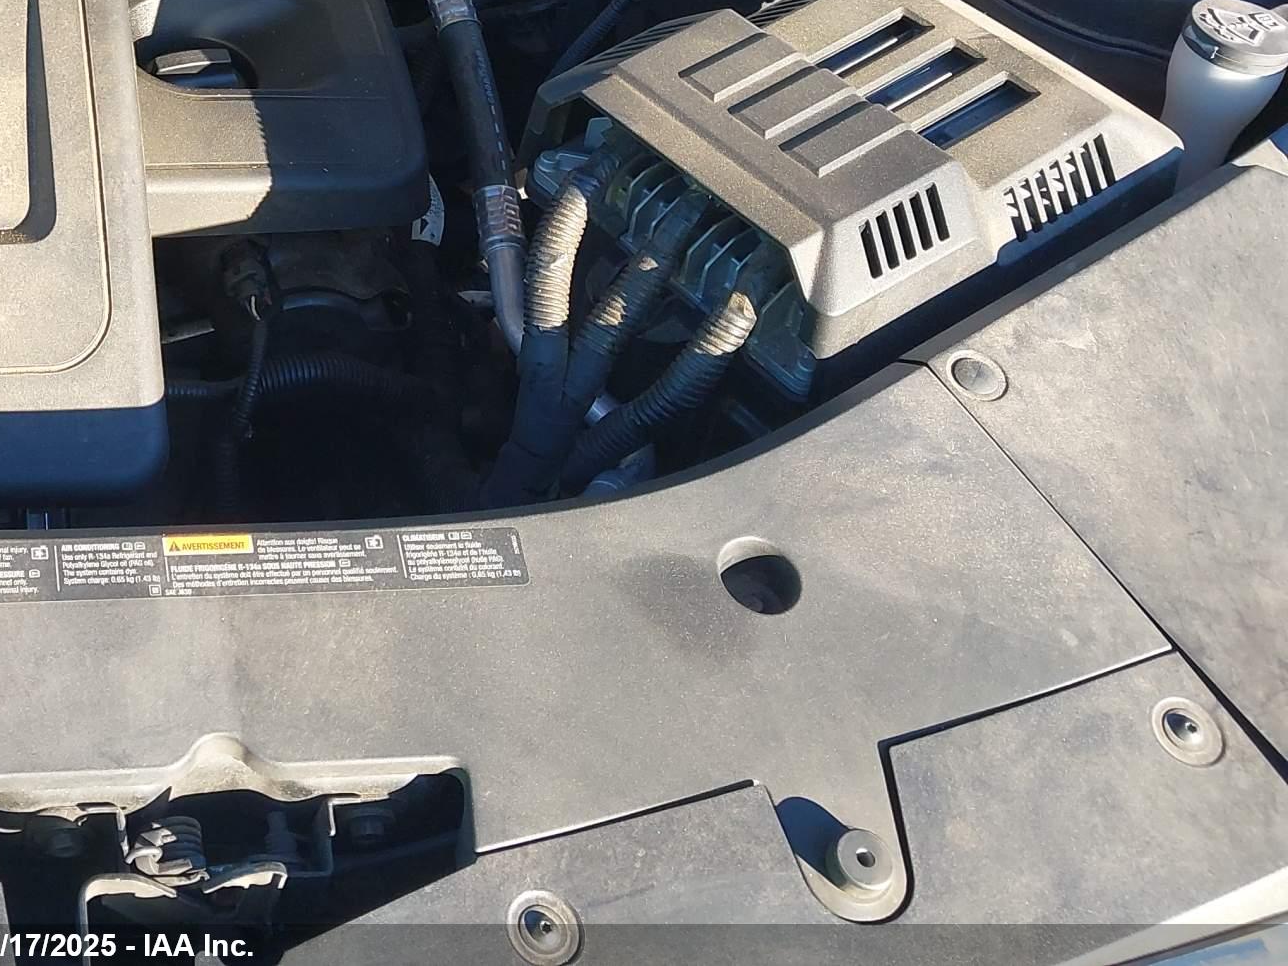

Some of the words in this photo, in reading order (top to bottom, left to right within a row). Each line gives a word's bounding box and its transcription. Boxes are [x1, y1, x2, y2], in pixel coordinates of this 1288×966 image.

[73, 543, 120, 551] CONDITIONING
[182, 542, 244, 550] AVERTISSEMENT
[101, 560, 119, 568] Glycol
[303, 560, 336, 568] PRESSION
